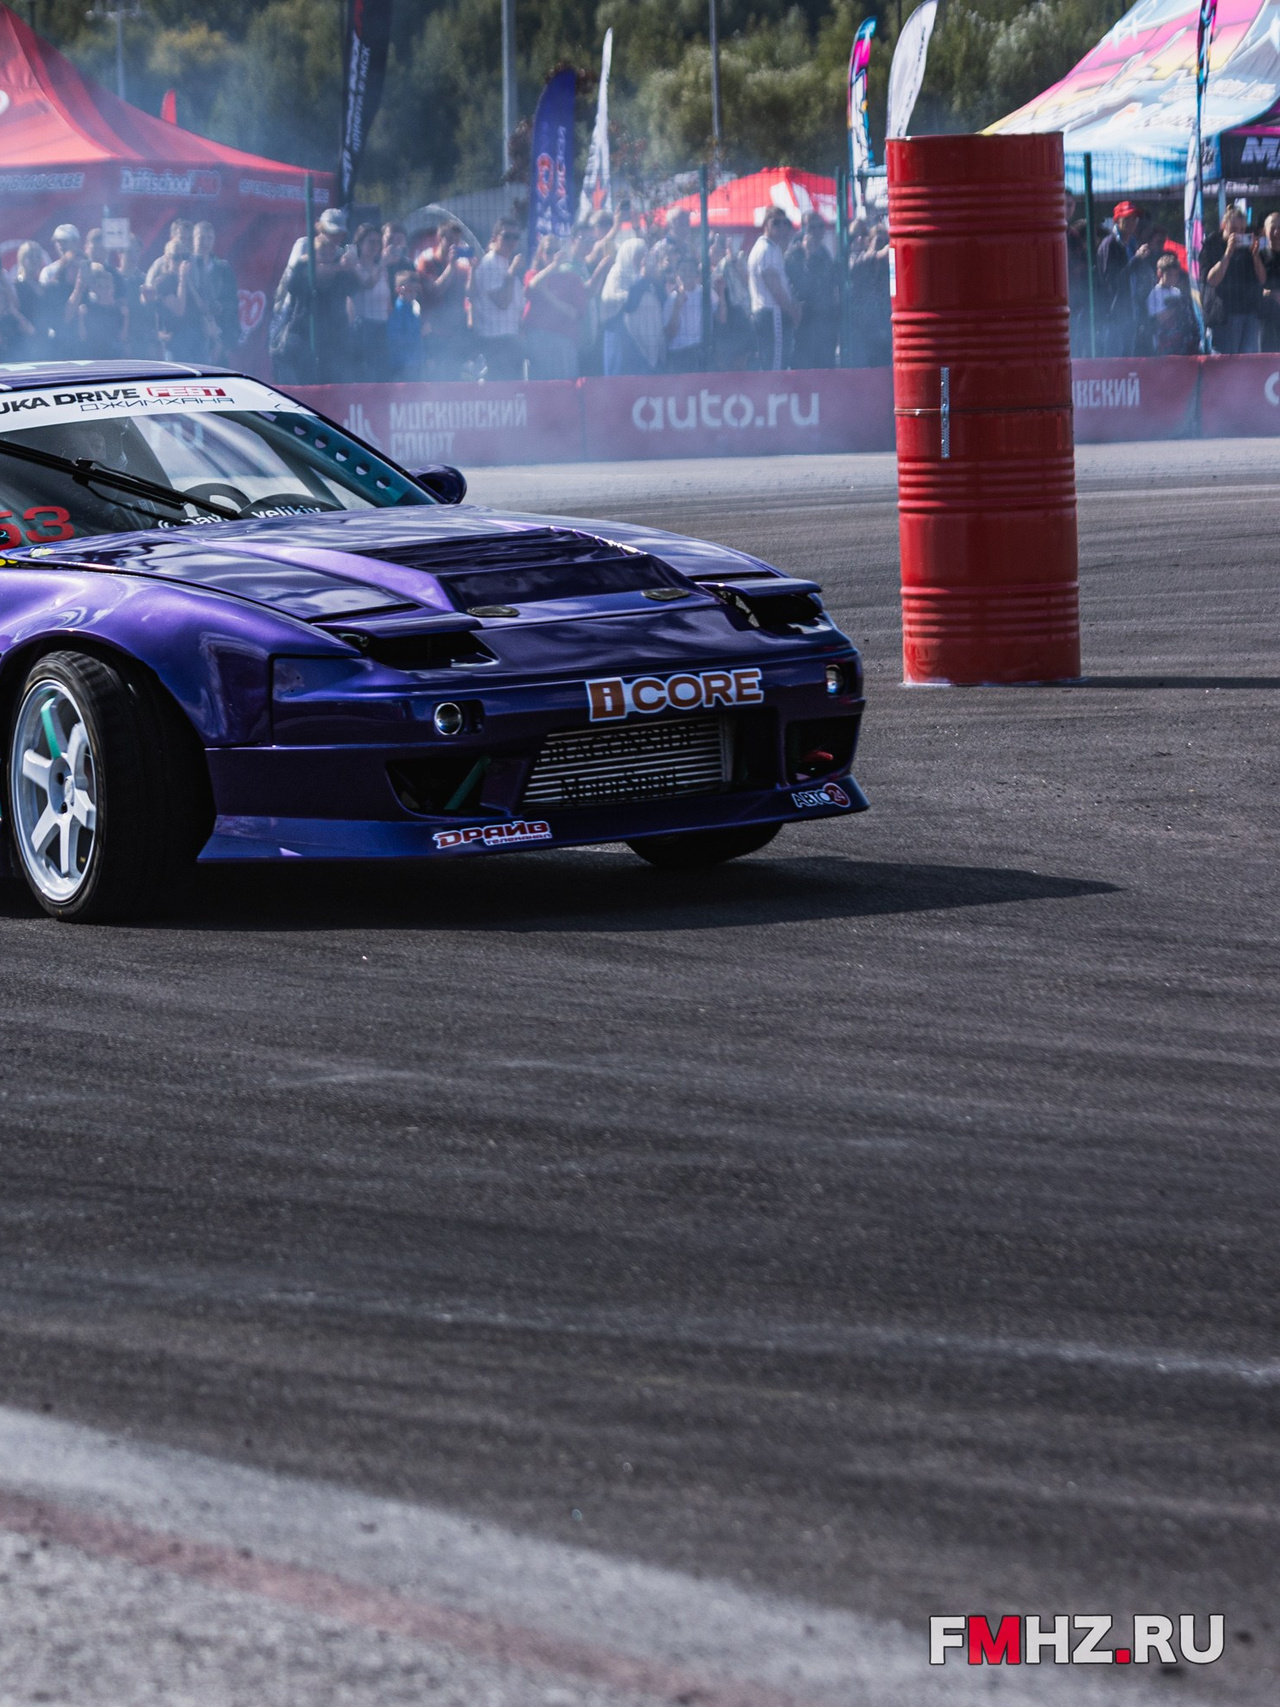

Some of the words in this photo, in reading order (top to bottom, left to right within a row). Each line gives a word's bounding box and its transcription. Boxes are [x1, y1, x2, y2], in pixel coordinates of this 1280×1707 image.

[53, 388, 140, 407] DRIVE
[148, 386, 226, 398] FEST
[389, 394, 528, 430] МОСКОВСКИЙ
[632, 388, 820, 430] auto.ru
[433, 821, 549, 847] ДРАЙВ
